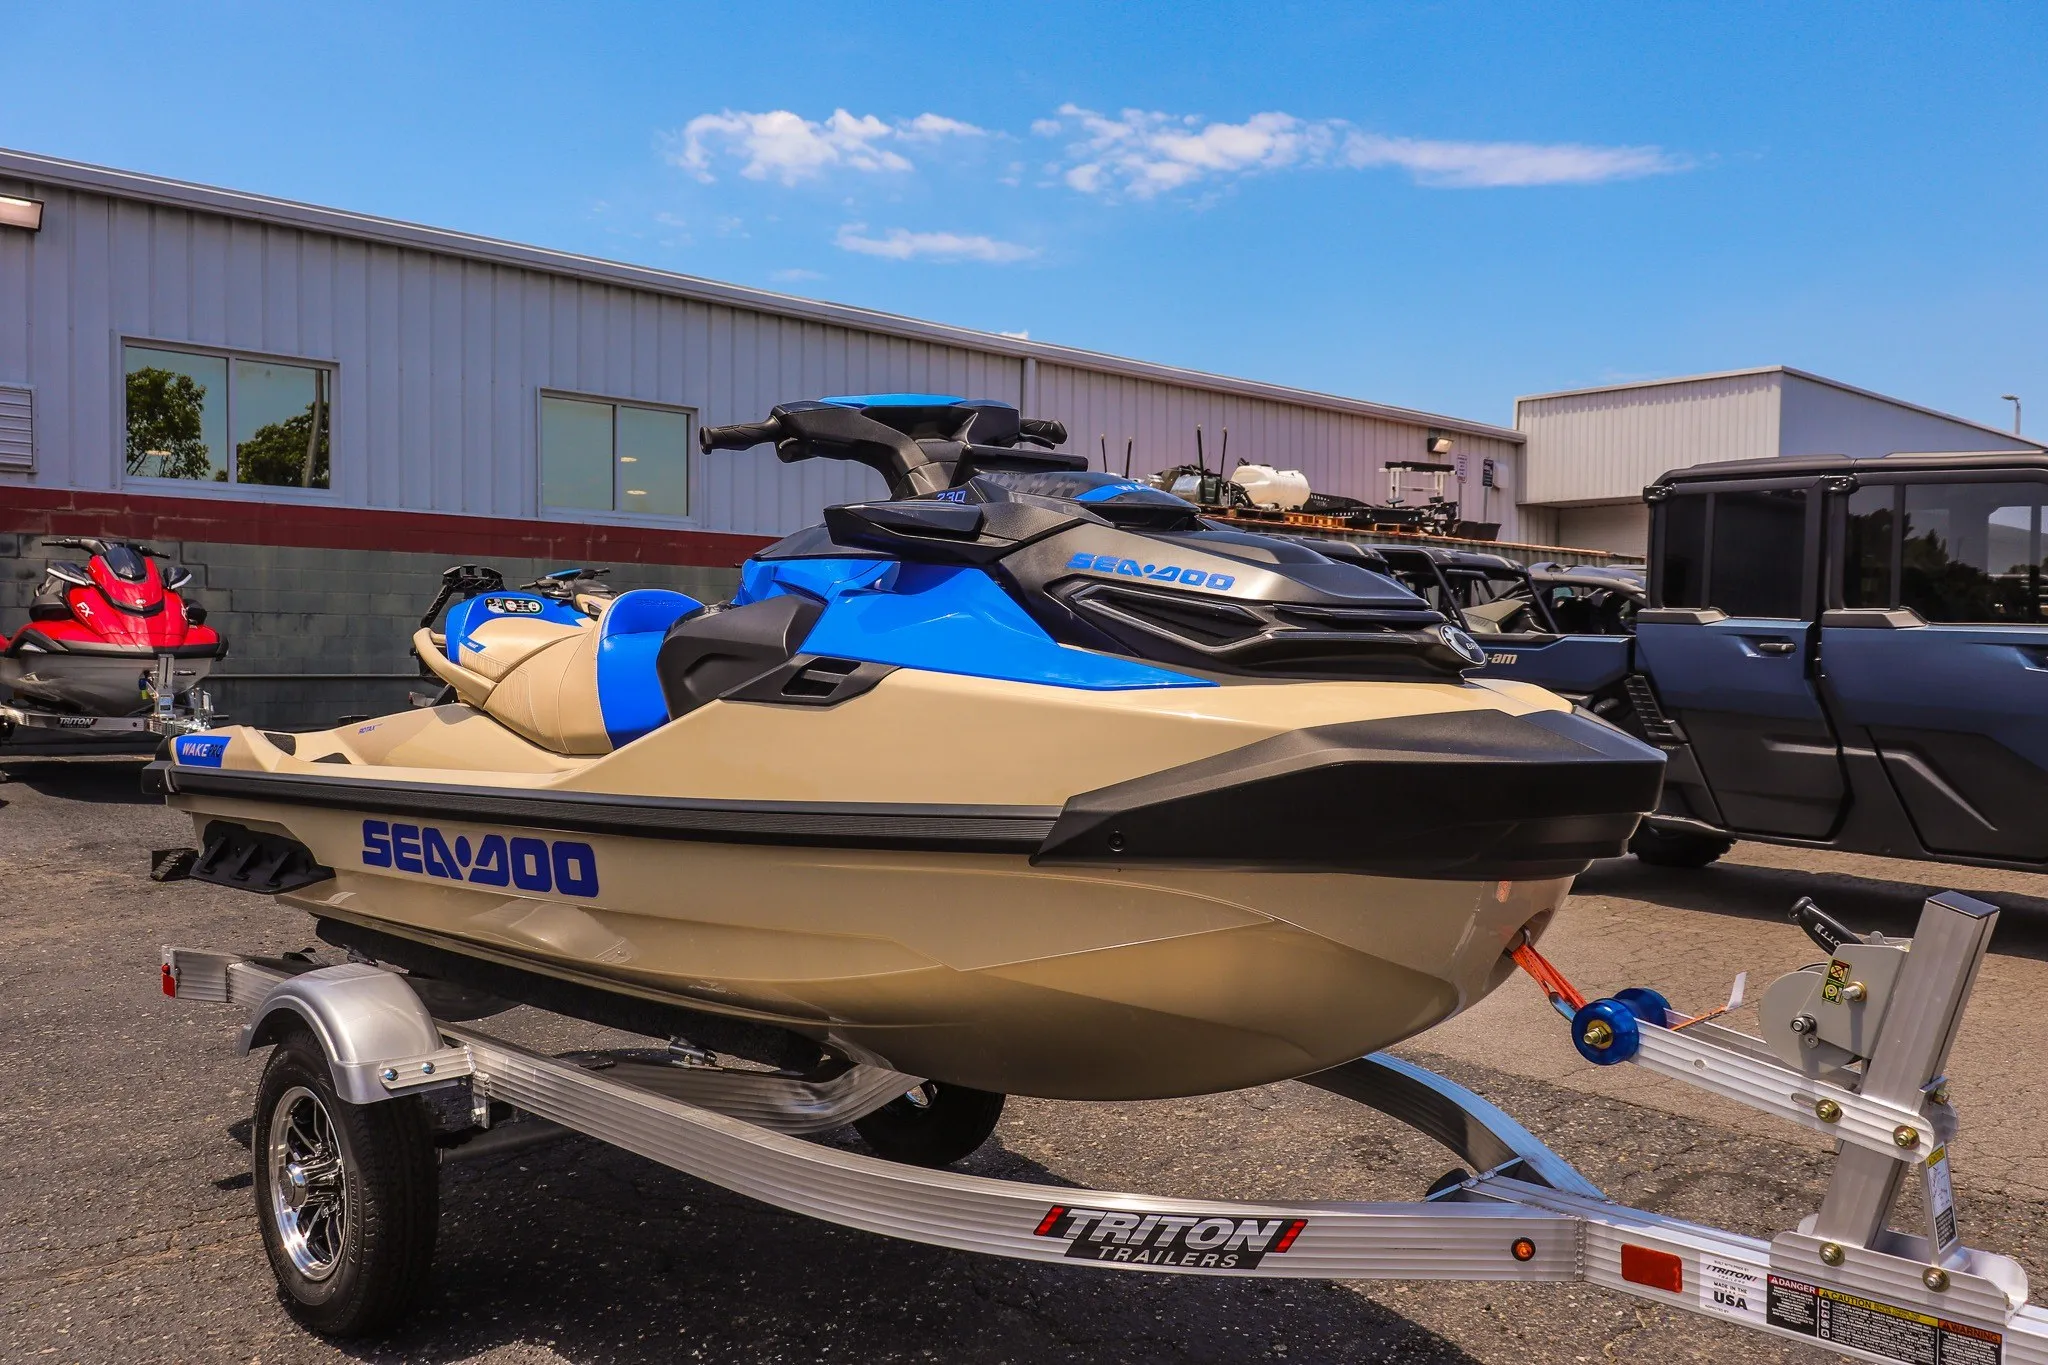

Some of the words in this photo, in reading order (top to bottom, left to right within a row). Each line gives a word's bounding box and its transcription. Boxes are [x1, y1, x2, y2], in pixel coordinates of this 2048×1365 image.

[77, 602, 94, 617] FX
[60, 717, 94, 725] TRITON
[1063, 1208, 1283, 1252] TRITON
[1099, 1245, 1240, 1268] TRAILERS
[1711, 1265, 1753, 1281] TRITON
[1713, 1281, 1728, 1290] MADE
[1778, 1279, 1816, 1295] DANGER
[1713, 1290, 1748, 1311] USA
[1831, 1292, 1872, 1310] CAUTION
[1951, 1323, 1998, 1343] WARNING
